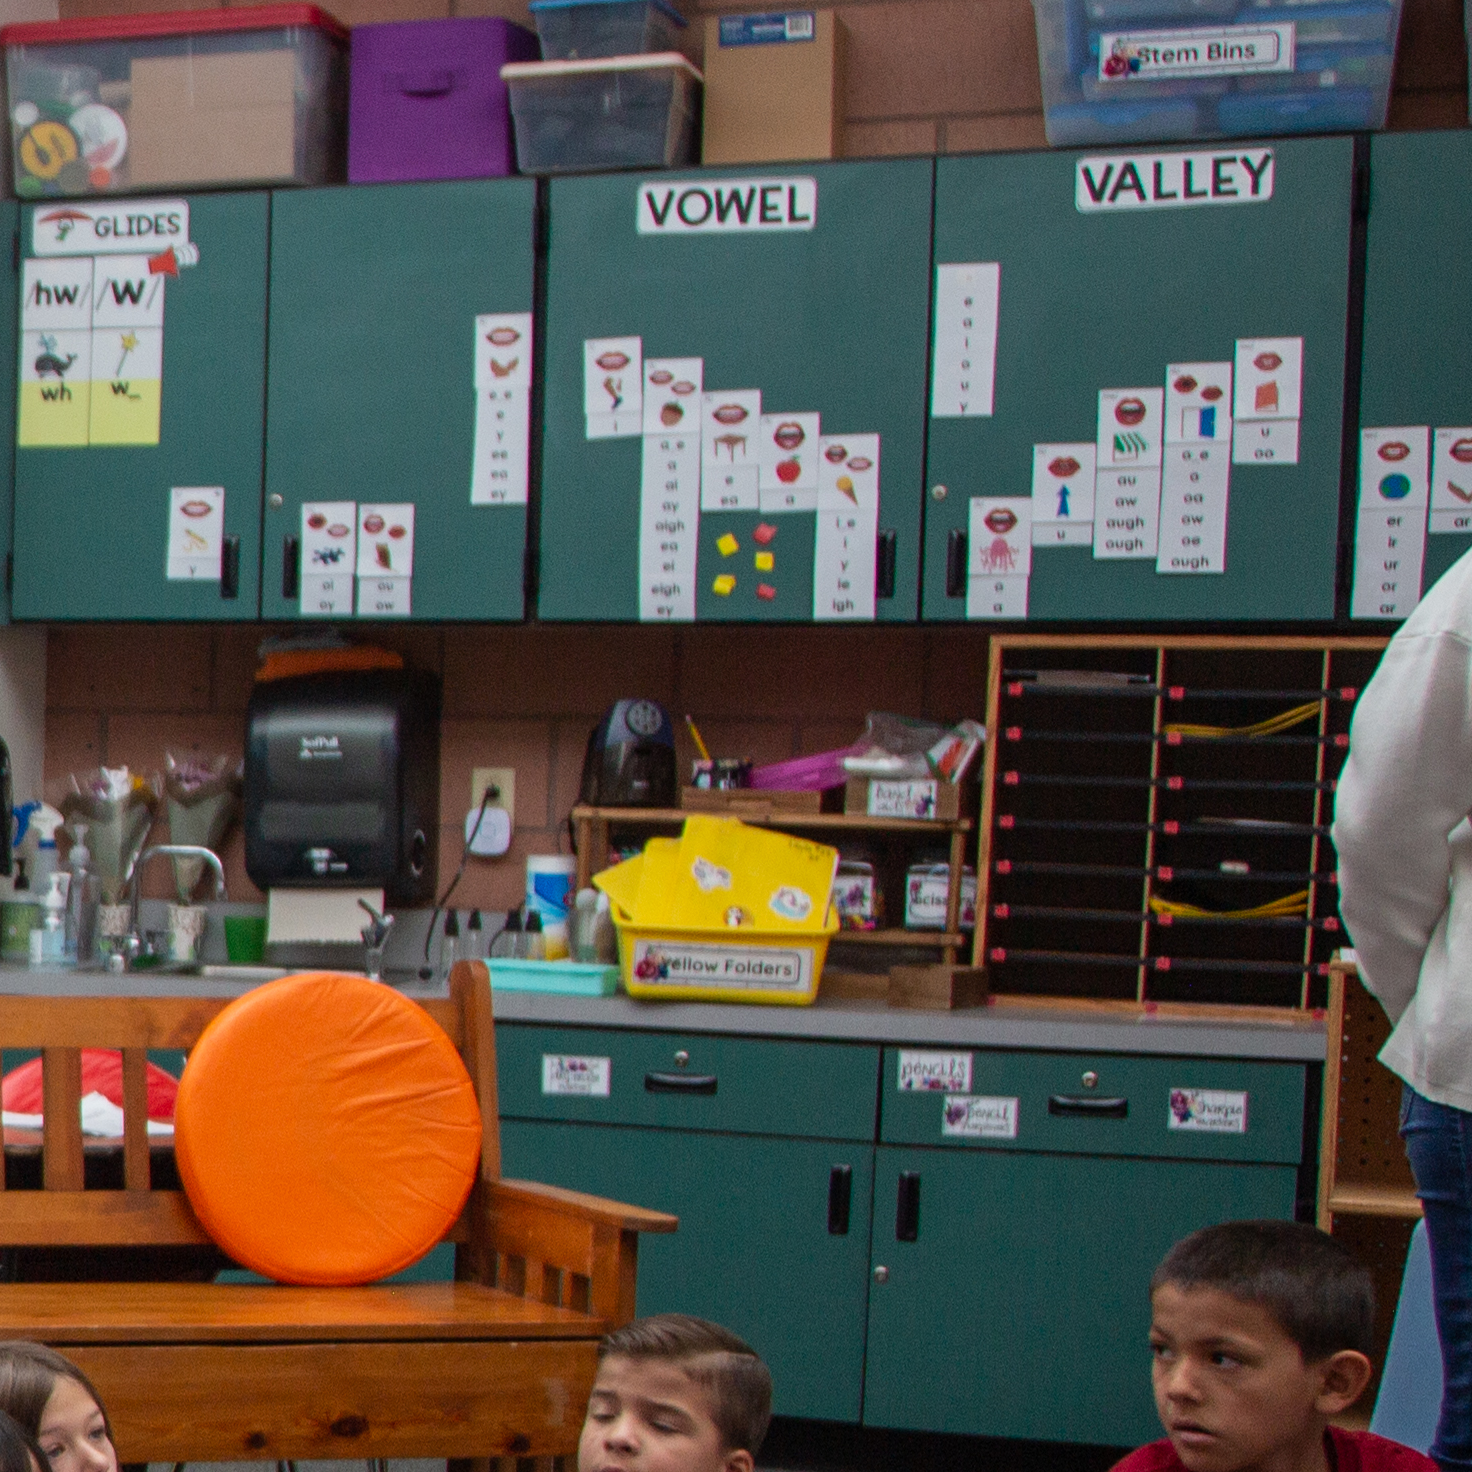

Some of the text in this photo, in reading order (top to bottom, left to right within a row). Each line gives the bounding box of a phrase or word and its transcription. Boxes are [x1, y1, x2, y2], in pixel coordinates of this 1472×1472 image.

[1137, 40, 1256, 65] Stem Bins
[1081, 152, 1273, 203] VALLEY
[645, 184, 811, 226] VOWEL
[94, 214, 182, 239] GLIDES
[40, 382, 72, 403] wh
[725, 960, 793, 977] Folders
